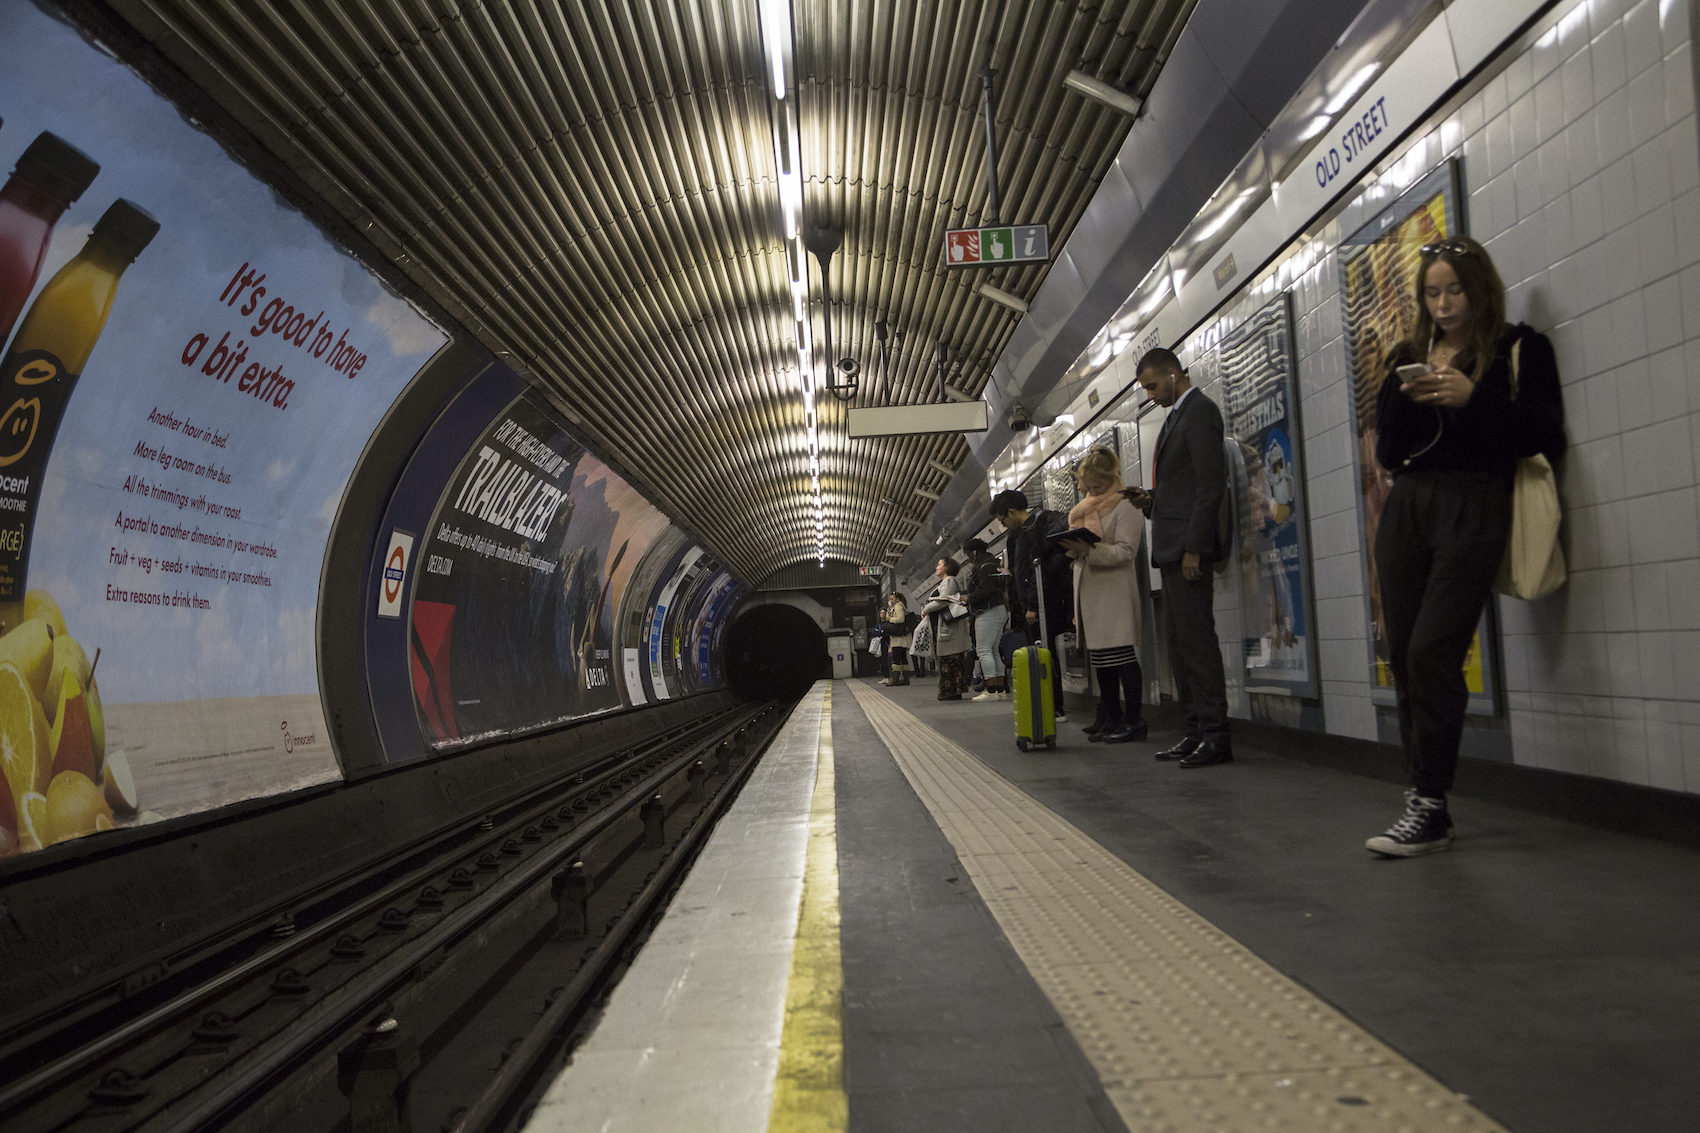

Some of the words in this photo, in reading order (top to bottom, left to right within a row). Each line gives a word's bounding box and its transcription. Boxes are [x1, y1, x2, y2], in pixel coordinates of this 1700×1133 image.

[1316, 148, 1340, 188] OLD
[1342, 95, 1388, 163] STREET
[219, 262, 266, 317] It's
[250, 297, 325, 348] good
[307, 319, 333, 359] to
[325, 328, 367, 380] have
[1142, 327, 1161, 353] STREET
[181, 333, 209, 367] a
[201, 331, 249, 384] bit
[238, 362, 296, 411] extra.
[147, 406, 183, 431] Another
[181, 417, 204, 440] hour
[202, 426, 213, 442] in
[211, 429, 230, 449] bed.
[492, 418, 518, 443] FOR
[505, 426, 529, 451] THE
[551, 458, 571, 479] THE
[133, 440, 157, 461] More
[157, 446, 173, 470] leg
[172, 456, 195, 474] room
[195, 464, 206, 477] on
[205, 463, 218, 480] the
[217, 466, 231, 484] bus.
[122, 474, 138, 494] All
[136, 477, 150, 497] the
[150, 483, 190, 510] trimmings
[190, 494, 207, 512] with
[205, 501, 224, 516] your
[223, 507, 242, 520] roast.
[0, 523, 24, 560] RGE}
[114, 510, 123, 528] A
[122, 515, 151, 534] portal
[150, 520, 160, 535] to
[159, 522, 191, 541] another
[190, 526, 226, 547] dimension
[226, 535, 234, 549] in
[233, 538, 249, 554] your
[249, 541, 278, 559] wardrobe.
[109, 547, 128, 565] Fruit
[130, 553, 136, 564] +
[137, 555, 152, 574] veg
[154, 556, 160, 568] +
[161, 556, 183, 574] seeds
[184, 561, 190, 572] +
[190, 560, 219, 580] vitamins
[219, 565, 227, 579] in
[226, 569, 242, 585] your
[243, 568, 272, 587] smoothies.
[106, 584, 128, 602] Extra
[130, 591, 161, 605] reasons
[162, 592, 171, 606] to
[171, 590, 191, 608] drink
[192, 592, 212, 610] them.
[292, 733, 316, 747] innocent
